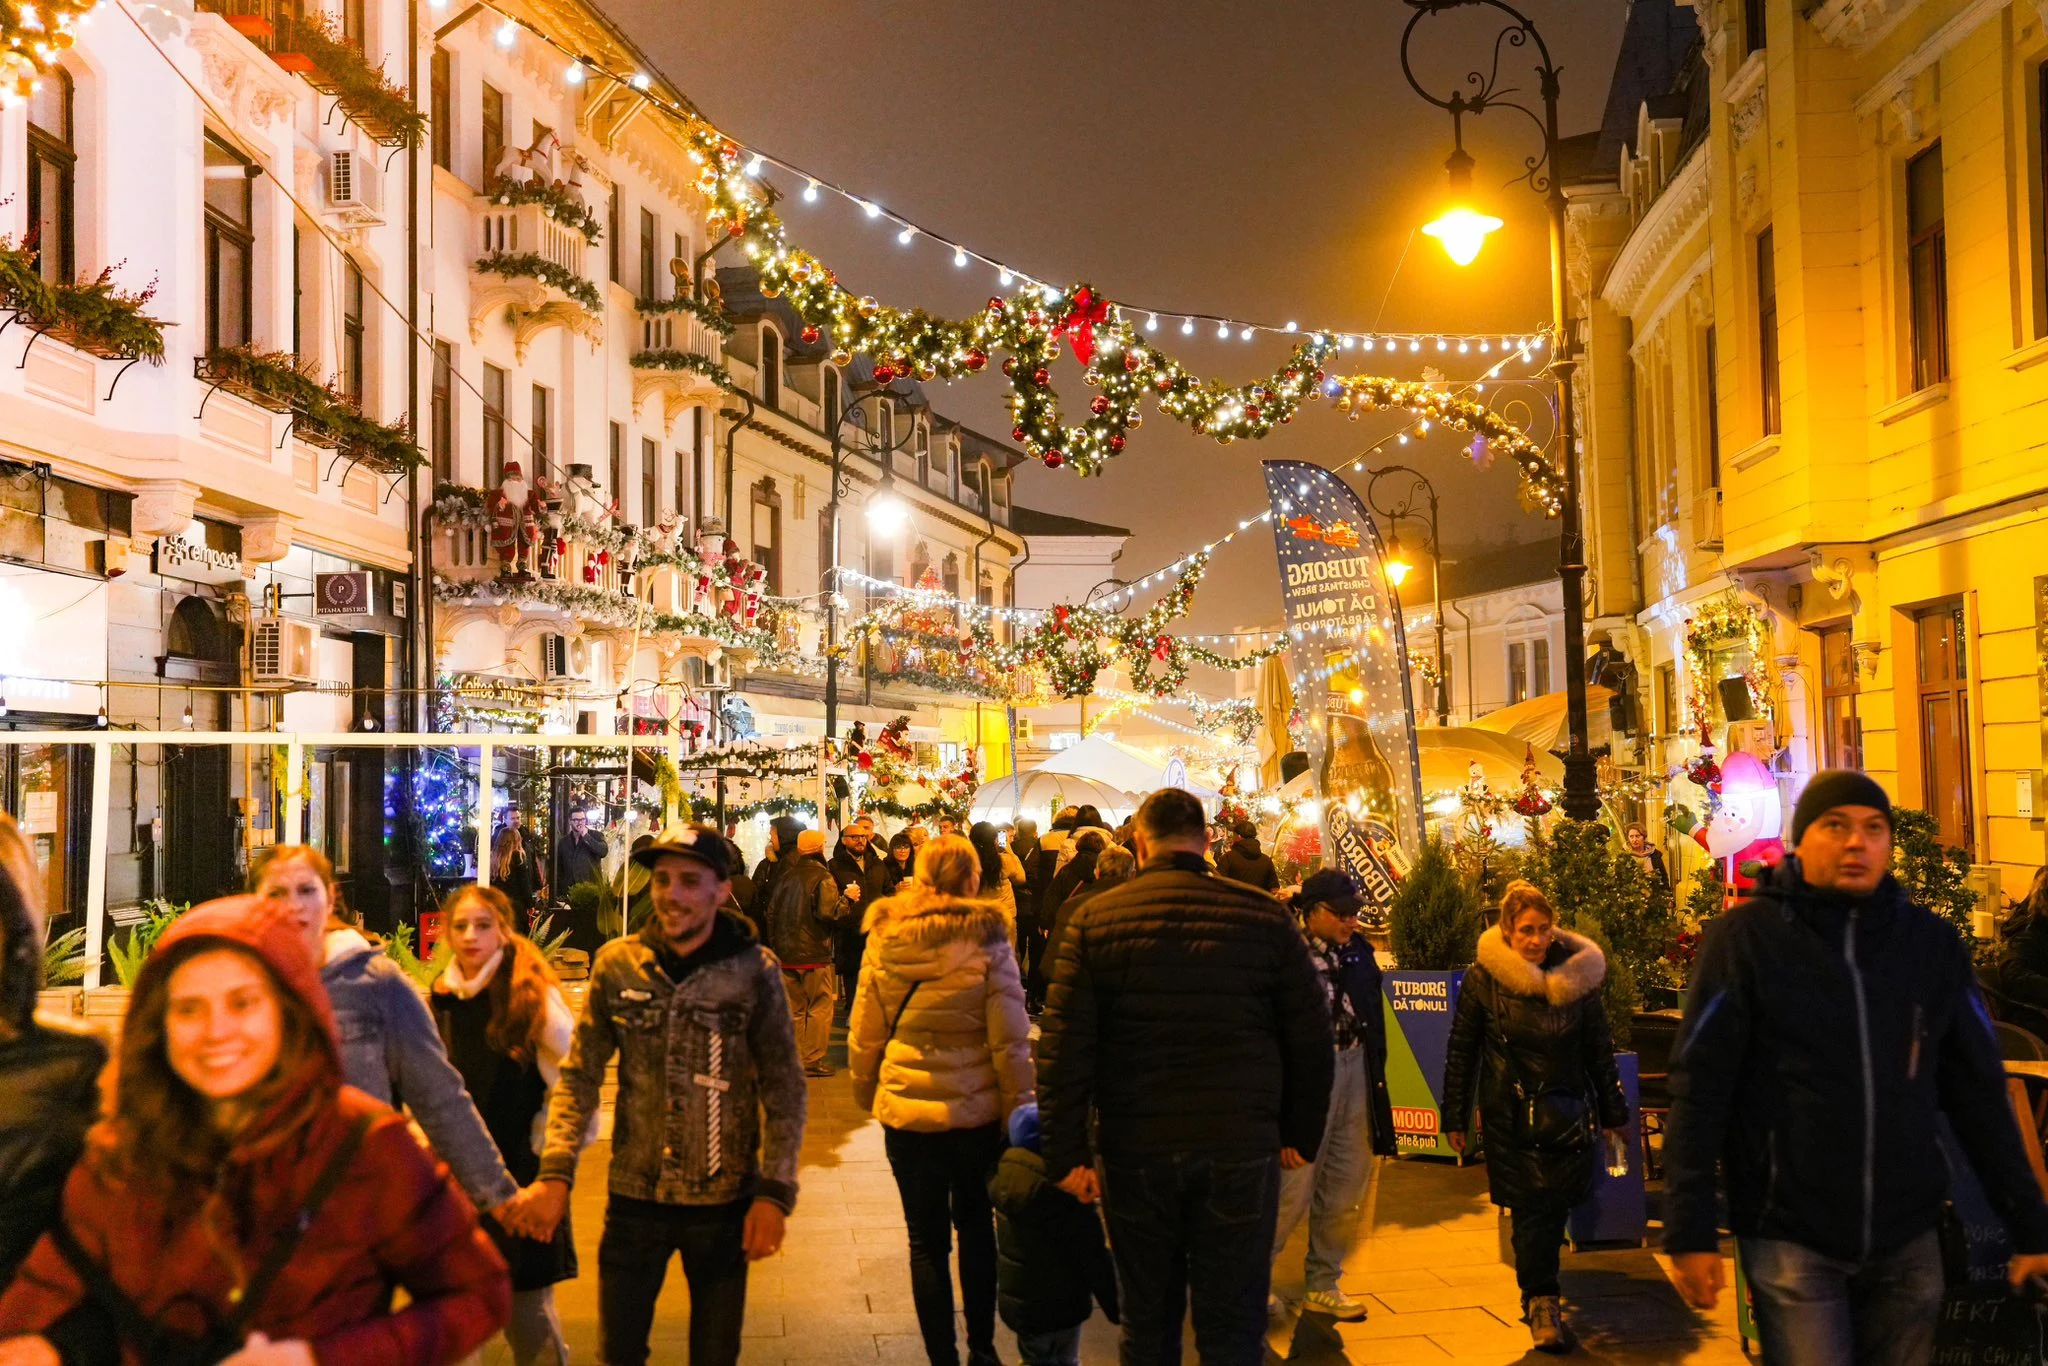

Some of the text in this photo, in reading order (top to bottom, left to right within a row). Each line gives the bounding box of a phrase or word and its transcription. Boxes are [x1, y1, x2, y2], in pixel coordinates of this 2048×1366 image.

[193, 545, 238, 570] empact
[319, 679, 350, 698] BISTRO
[1392, 980, 1447, 997] TUBORG
[1393, 998, 1408, 1010] DĂ
[1392, 1109, 1434, 1130] MOOD
